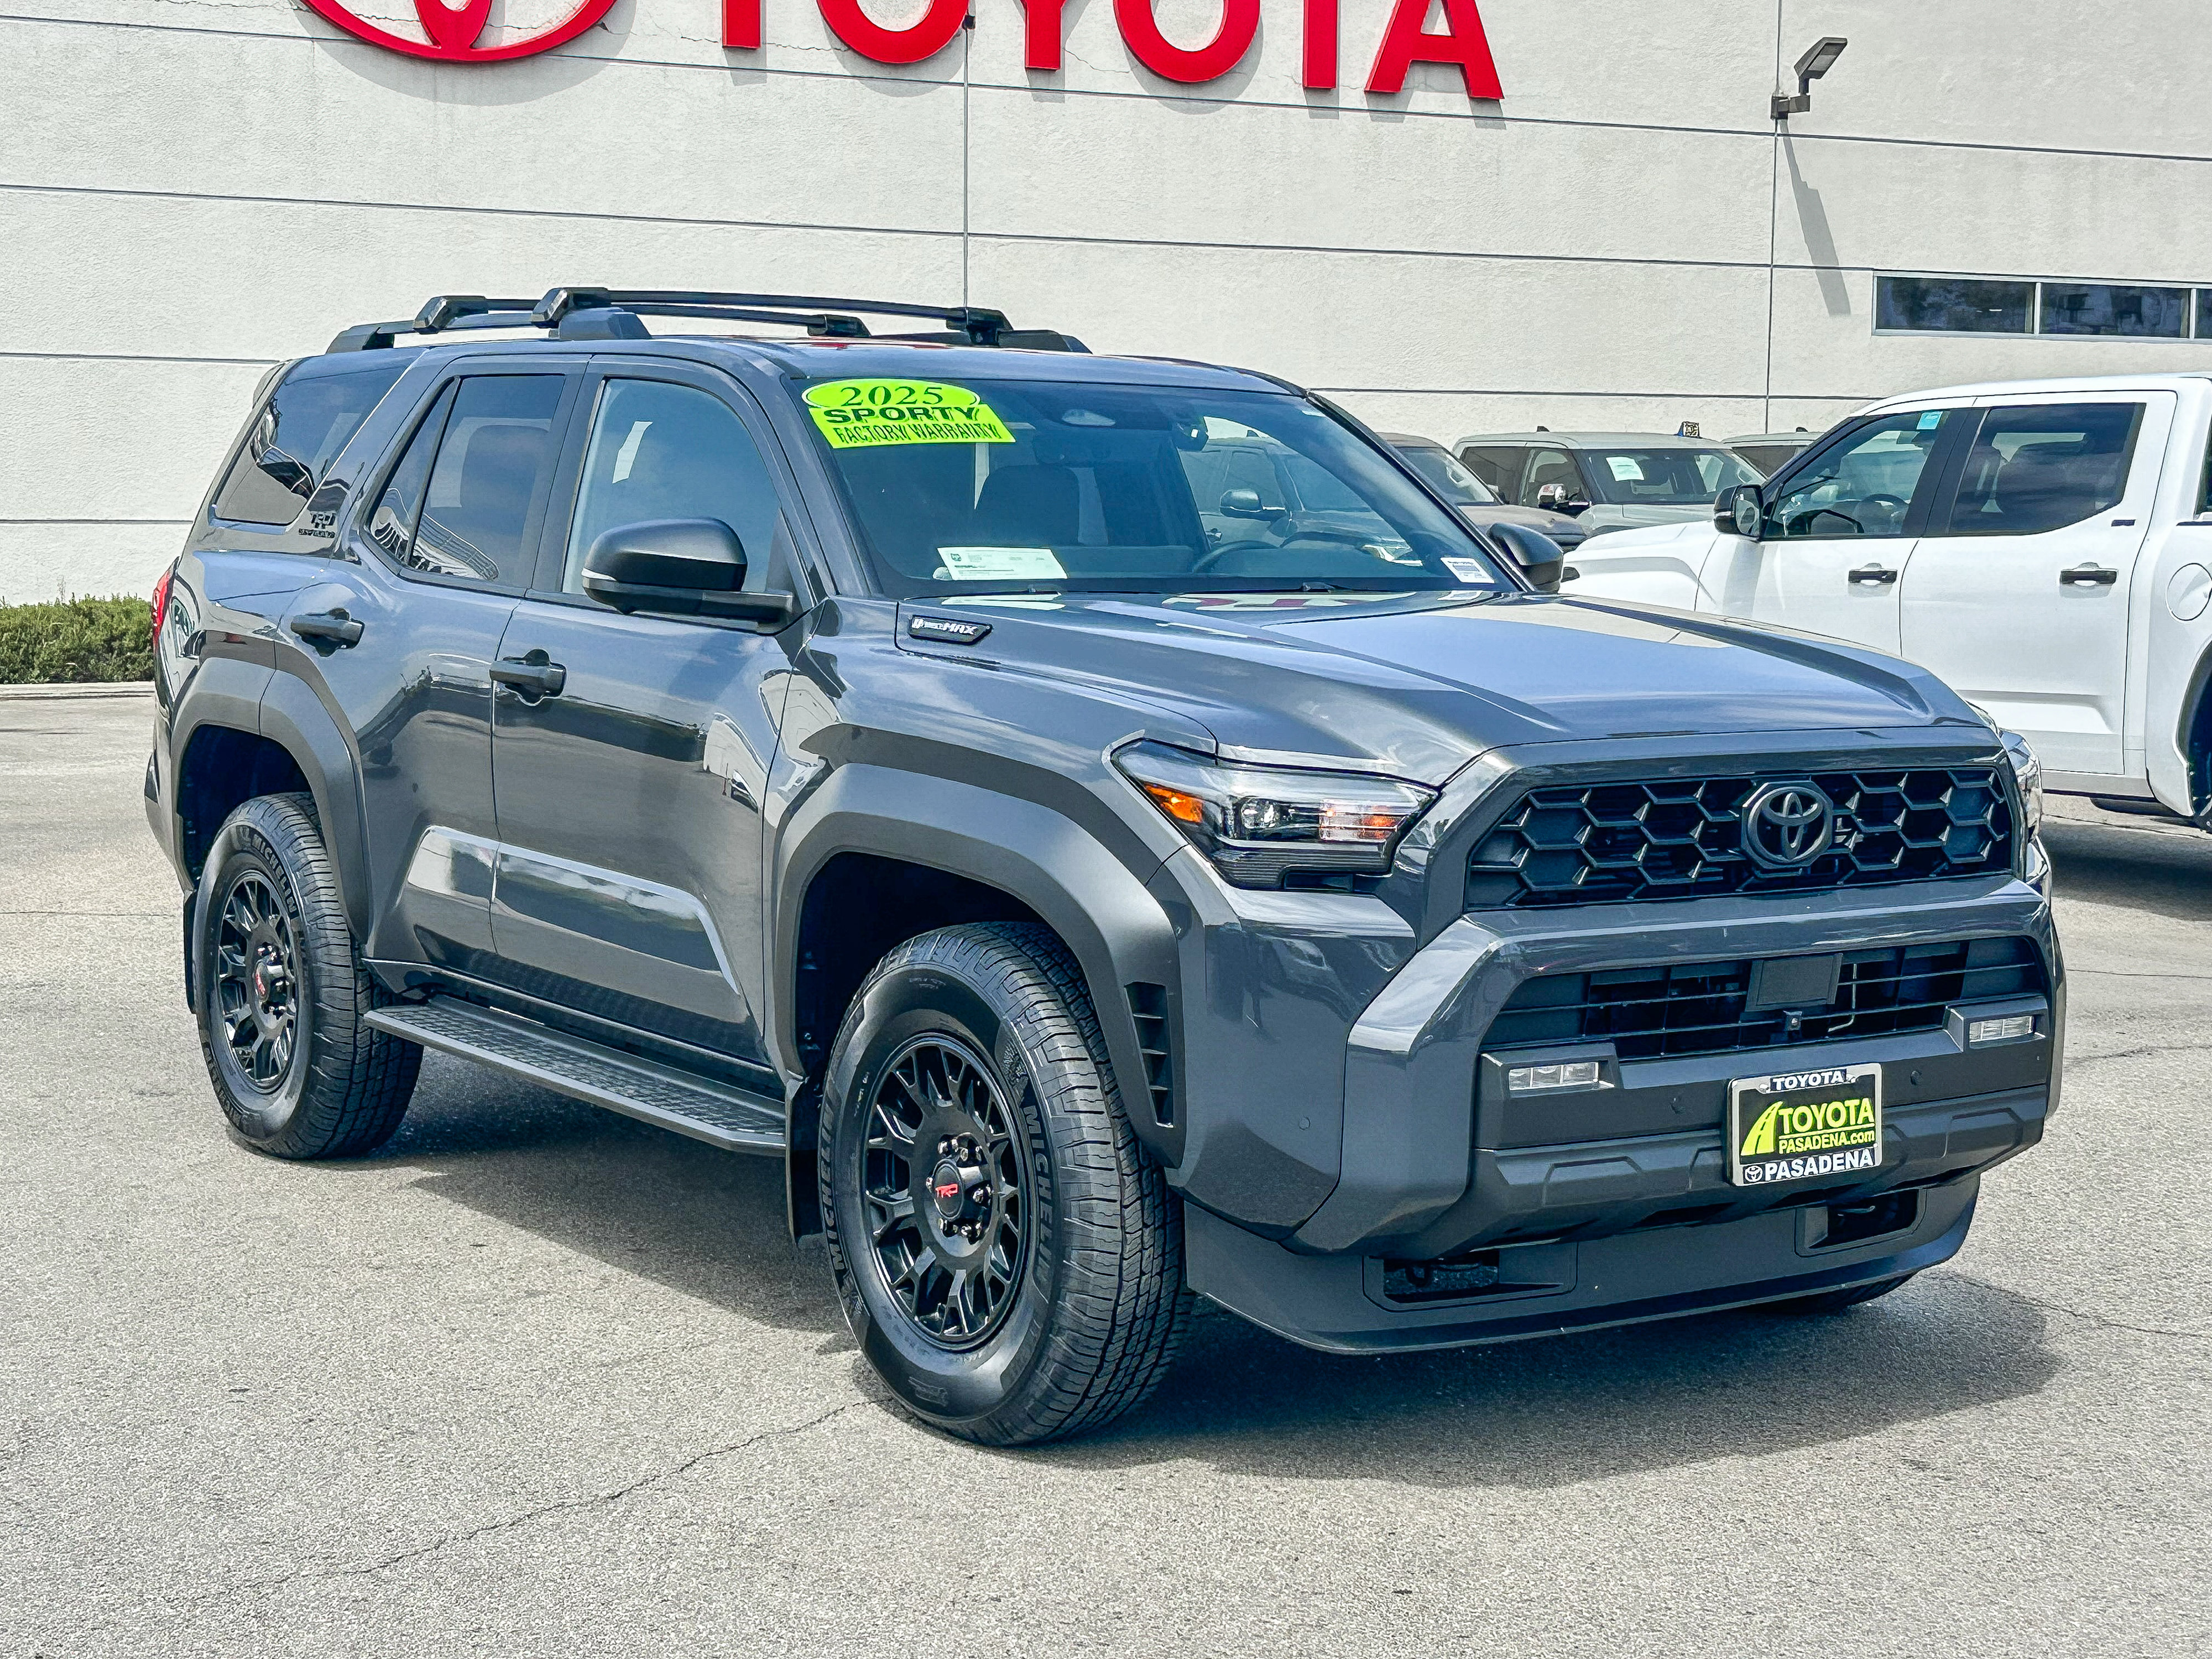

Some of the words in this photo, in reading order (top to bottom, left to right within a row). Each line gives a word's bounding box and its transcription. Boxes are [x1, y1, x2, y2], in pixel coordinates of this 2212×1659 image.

[841, 385, 943, 406] 2025
[823, 407, 979, 424] SPORTY
[833, 424, 909, 442] FACTORY
[907, 422, 1003, 440] WARRANTY
[1772, 1070, 1844, 1091] TOYOTA
[1777, 1098, 1875, 1134] TOYOTA
[1778, 1130, 1875, 1155] PASADENA.com
[1764, 1149, 1874, 1181] PASADENA
[1023, 1105, 1053, 1284] MICHELIN
